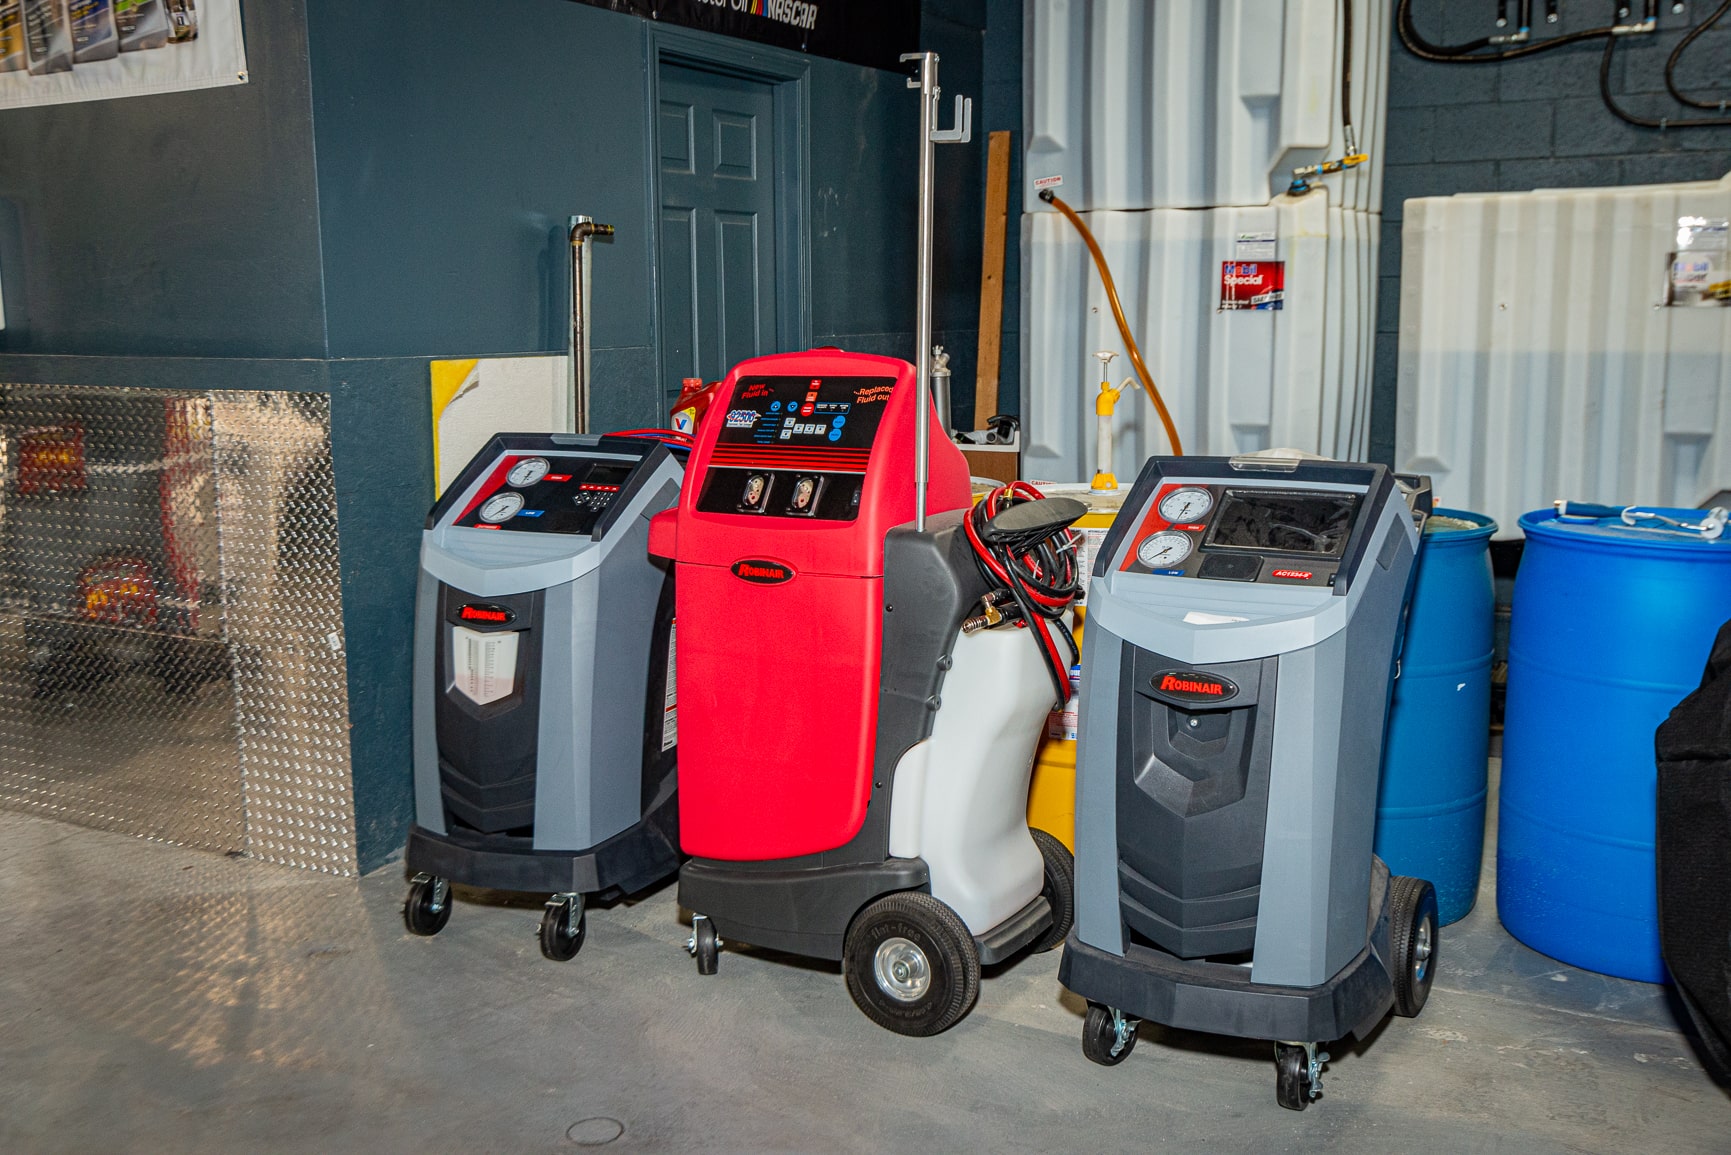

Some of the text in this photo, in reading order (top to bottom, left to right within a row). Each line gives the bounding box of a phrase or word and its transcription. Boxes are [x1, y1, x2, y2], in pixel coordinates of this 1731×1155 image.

[766, 0, 818, 30] NASCAR
[1034, 176, 1062, 186] CAUTION
[1224, 263, 1258, 276] Mobil
[1223, 274, 1264, 287] Special
[857, 394, 877, 404] Fluid
[738, 563, 785, 579] ROBINAIR
[461, 606, 506, 621] ROBINAIR
[1160, 675, 1223, 695] ROBINAIR
